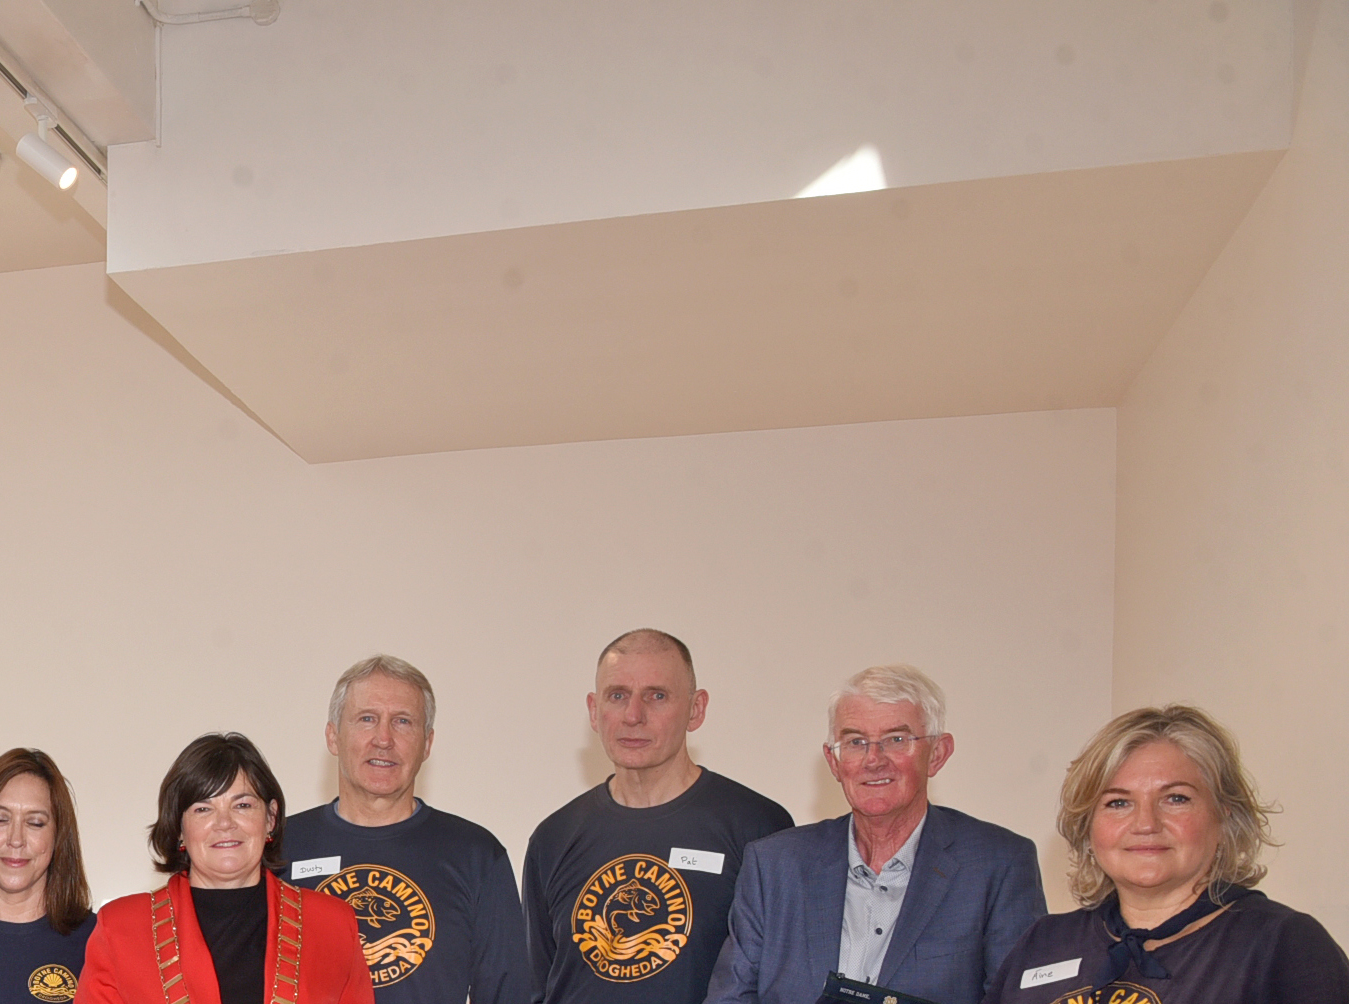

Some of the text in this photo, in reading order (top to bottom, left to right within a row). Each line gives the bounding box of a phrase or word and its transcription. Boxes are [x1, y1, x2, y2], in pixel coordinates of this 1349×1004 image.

[300, 865, 323, 874] Dusty
[681, 856, 698, 865] Pat
[367, 871, 429, 930] CAMINO
[577, 861, 686, 926] BOYNE CAMINO
